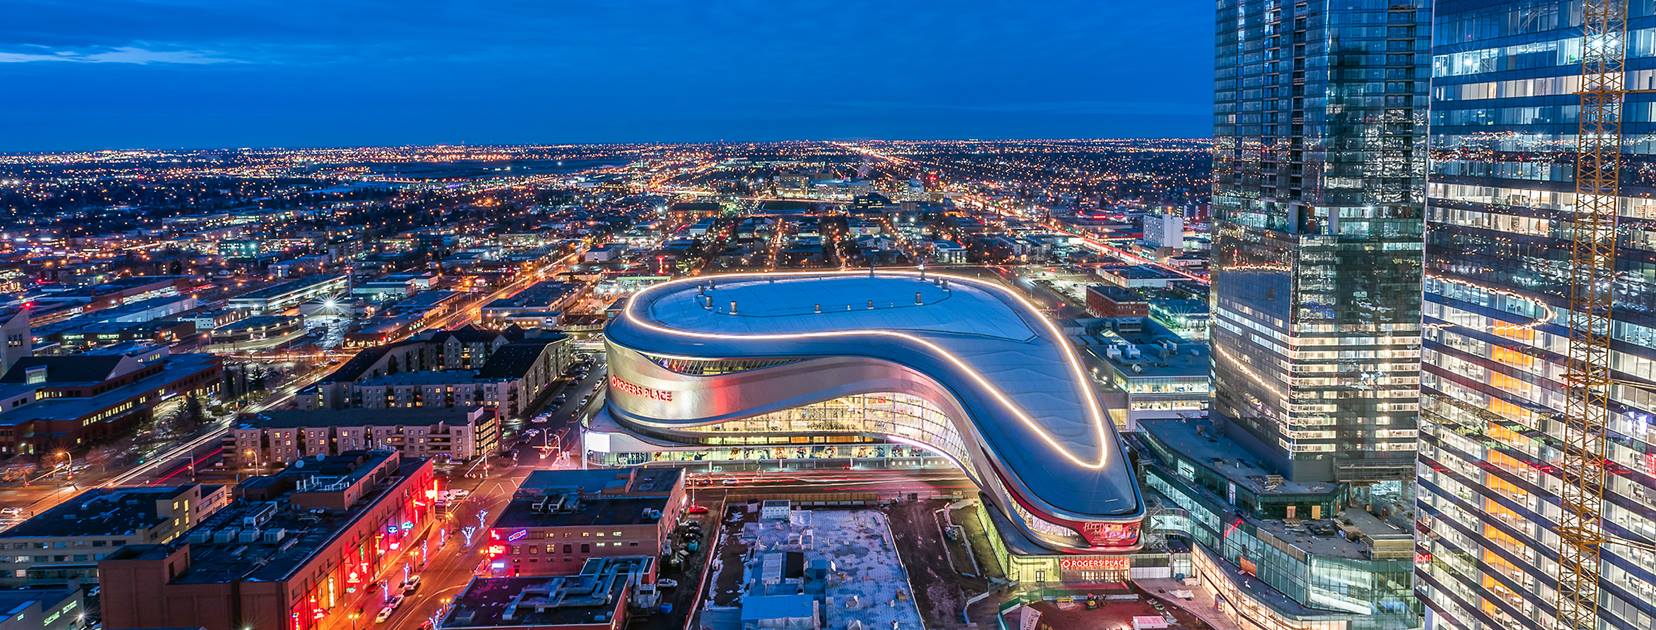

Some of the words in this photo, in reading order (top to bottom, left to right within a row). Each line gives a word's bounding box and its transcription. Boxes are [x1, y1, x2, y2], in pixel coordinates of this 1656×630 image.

[617, 378, 642, 396] ROGERS
[645, 388, 672, 401] PLACE
[1071, 559, 1104, 567] ROGERS
[1105, 559, 1129, 567] PLACE
